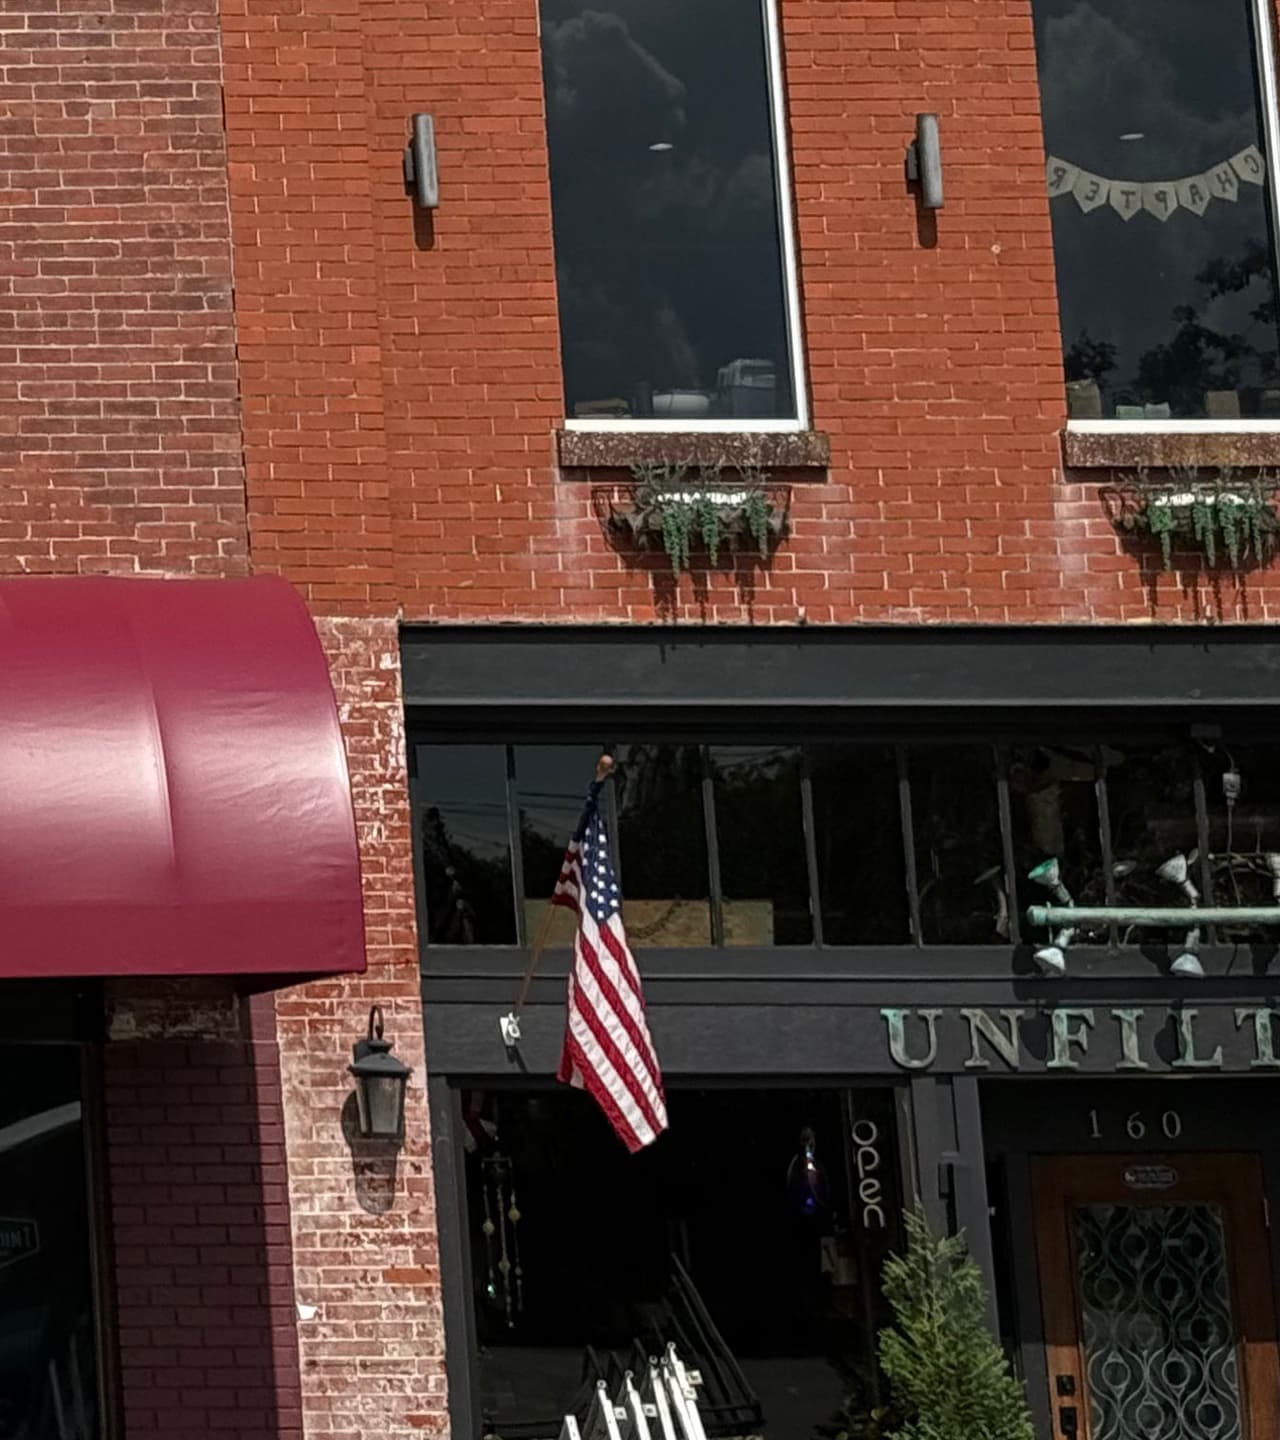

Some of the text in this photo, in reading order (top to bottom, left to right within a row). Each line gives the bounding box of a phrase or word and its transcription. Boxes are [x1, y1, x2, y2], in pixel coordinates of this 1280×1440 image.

[879, 1007, 1280, 1069] UNFILT
[1086, 1108, 1182, 1140] 160
[851, 1119, 886, 1229] open
